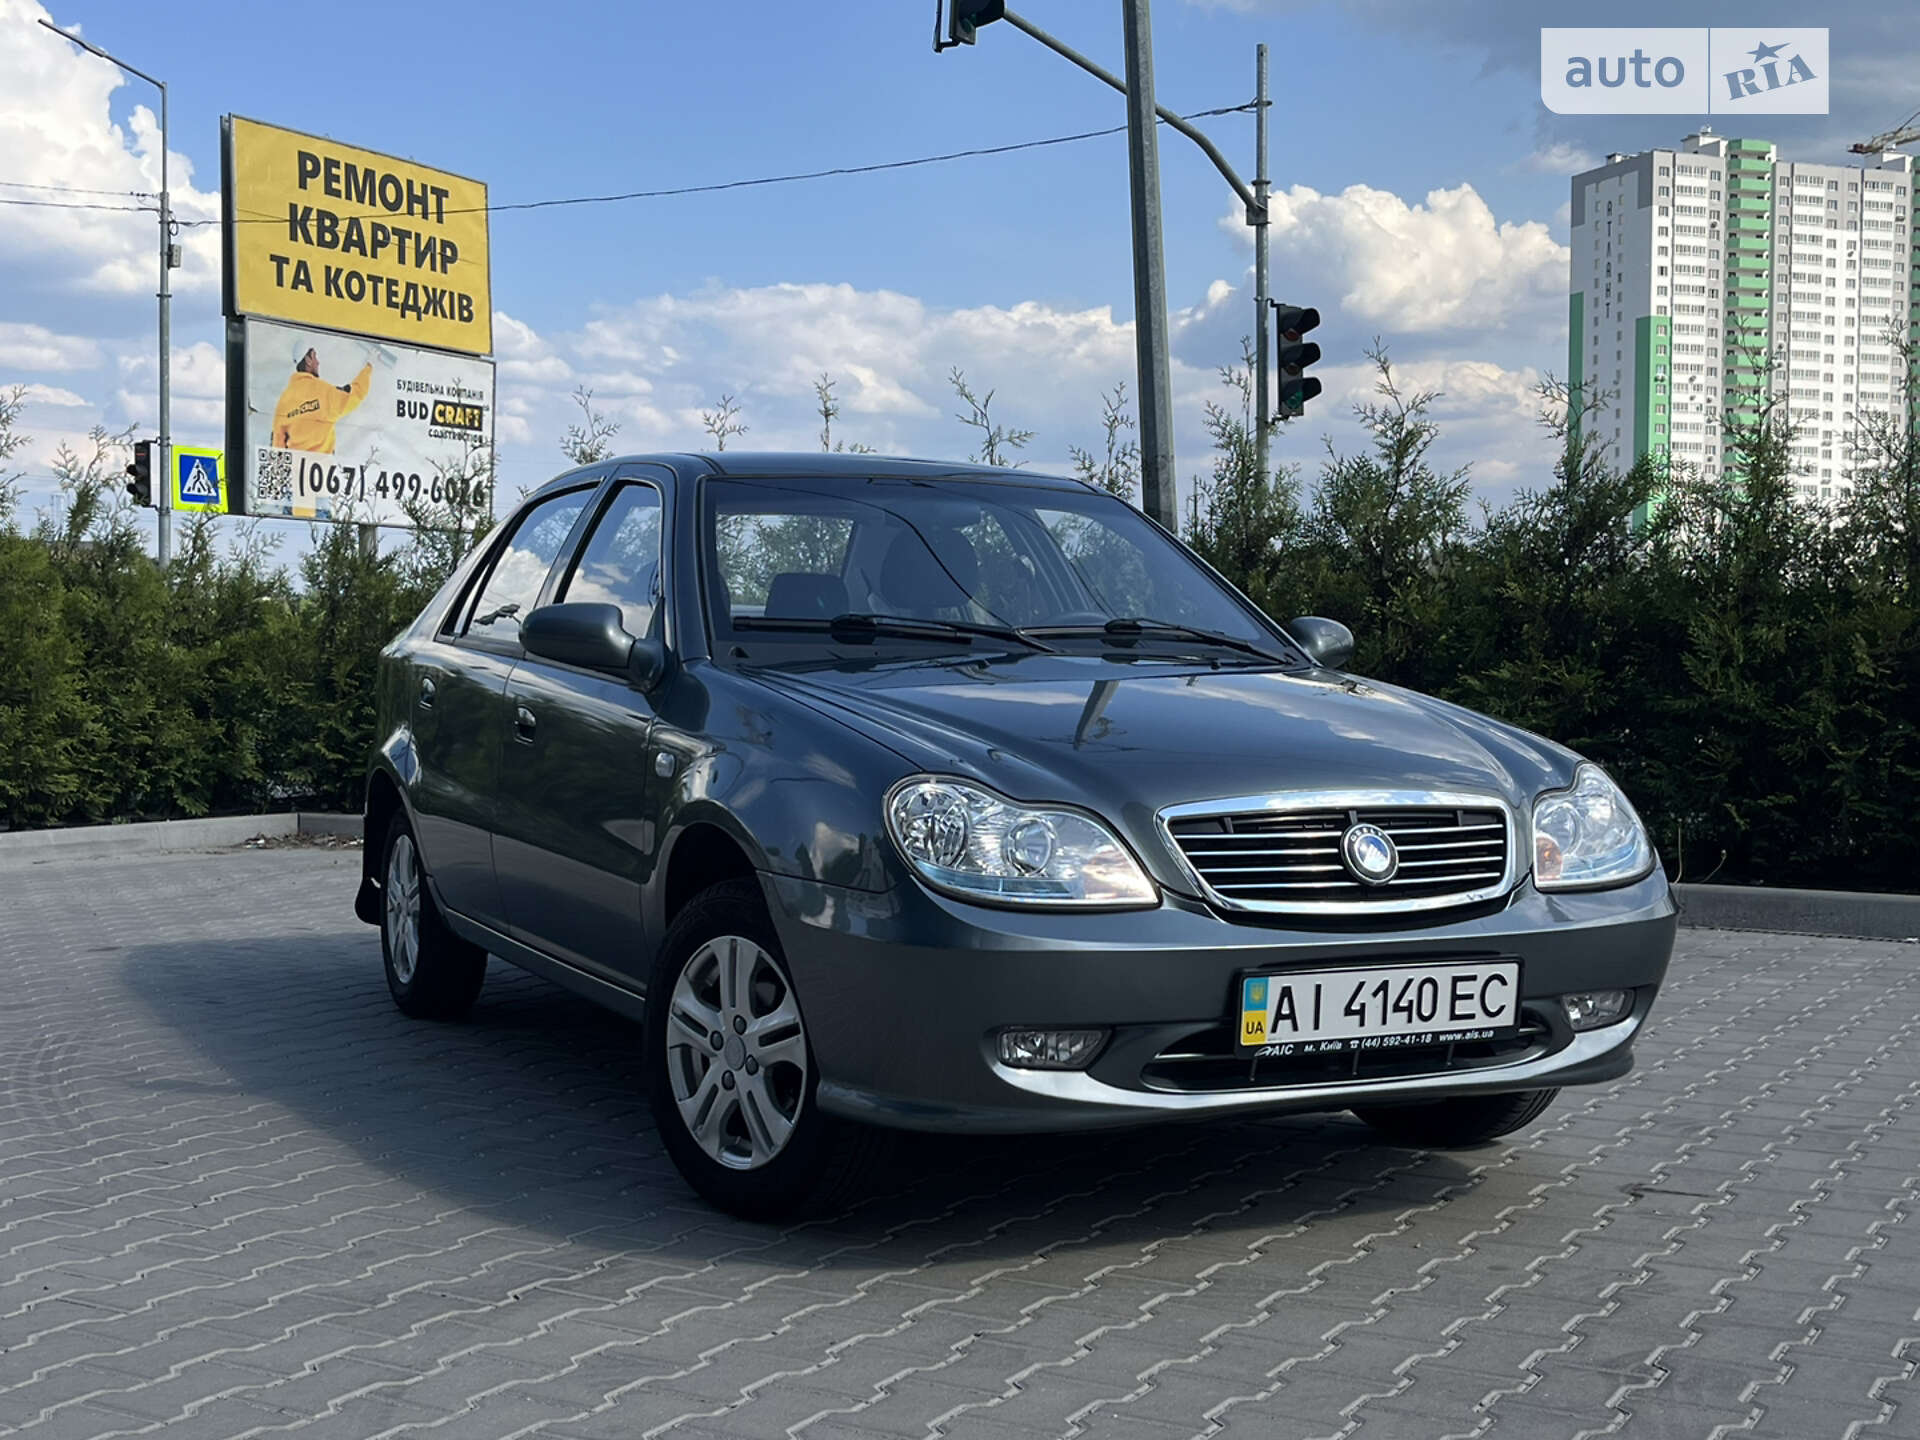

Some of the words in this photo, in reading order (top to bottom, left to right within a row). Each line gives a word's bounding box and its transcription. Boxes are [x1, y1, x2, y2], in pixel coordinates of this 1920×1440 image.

[297, 150, 449, 224] РЕМОНТ
[288, 202, 458, 275] КВАРТИР
[269, 254, 314, 294] ТА
[324, 265, 474, 323] КОТЕДЖІВ
[396, 379, 444, 395] БУДІВЕЛЬНА
[396, 399, 429, 420] BUD
[434, 403, 482, 428] CRAFT
[299, 457, 365, 503] (067)
[1270, 983, 1322, 1033] AI
[1343, 976, 1439, 1028] 4140
[1449, 973, 1508, 1022] EC
[1245, 1021, 1265, 1035] UA
[1320, 1040, 1342, 1051] Київ
[1361, 1037, 1381, 1049] (44)
[1382, 1033, 1433, 1047] 592-41-18
[1439, 1029, 1494, 1041] www.ais.ua
